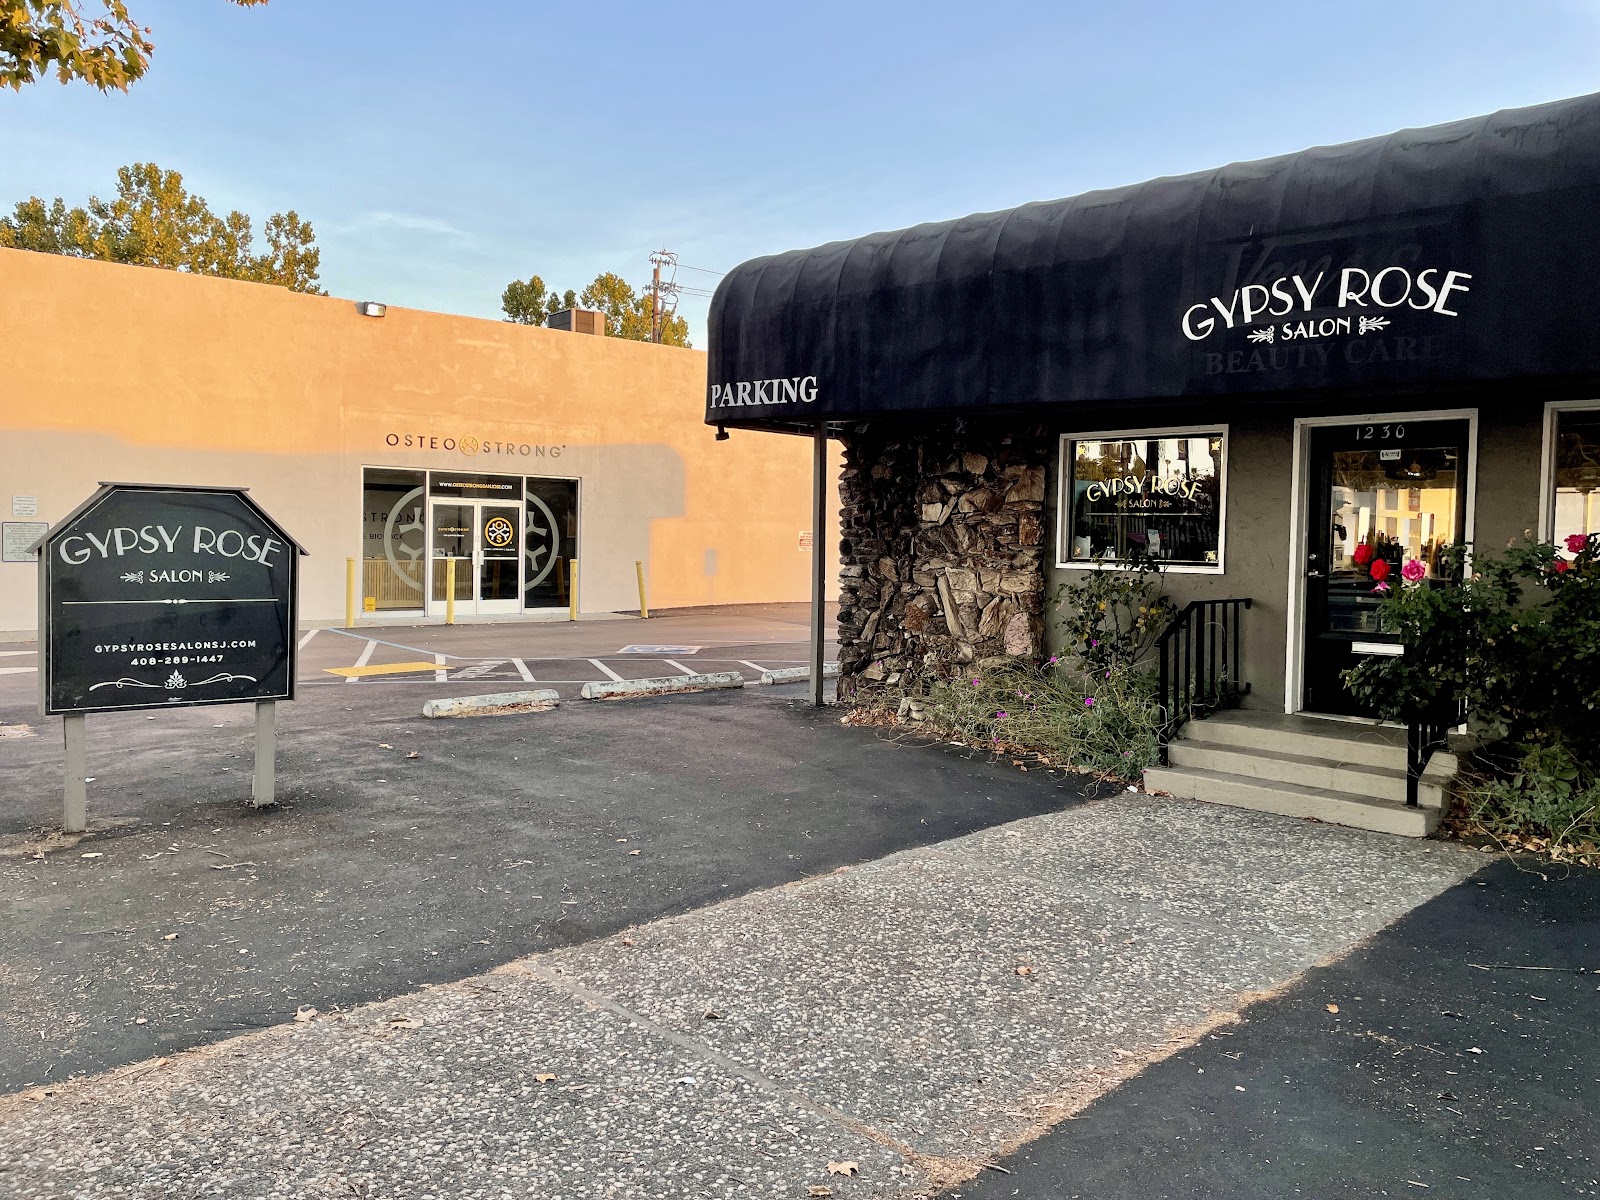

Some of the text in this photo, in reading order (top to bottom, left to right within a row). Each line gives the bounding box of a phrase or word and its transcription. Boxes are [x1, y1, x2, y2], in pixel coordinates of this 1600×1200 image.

[1181, 271, 1324, 341] GYPSY
[1337, 266, 1473, 317] ROSE
[1281, 316, 1351, 341] SALON
[1206, 334, 1443, 376] BEAUTY CARE
[710, 376, 819, 409] PARKING
[1356, 424, 1405, 441] 1230
[386, 433, 562, 458] OSTEO STRONG
[1086, 475, 1203, 503] GYPSY ROSE
[1128, 499, 1157, 508] SALON
[59, 525, 183, 565] GYPSY
[193, 526, 282, 567] ROSE
[149, 569, 203, 583] SALON
[94, 640, 257, 653] GYPSYROSESALONSJ.COM
[130, 655, 224, 666] 408-289-1447
